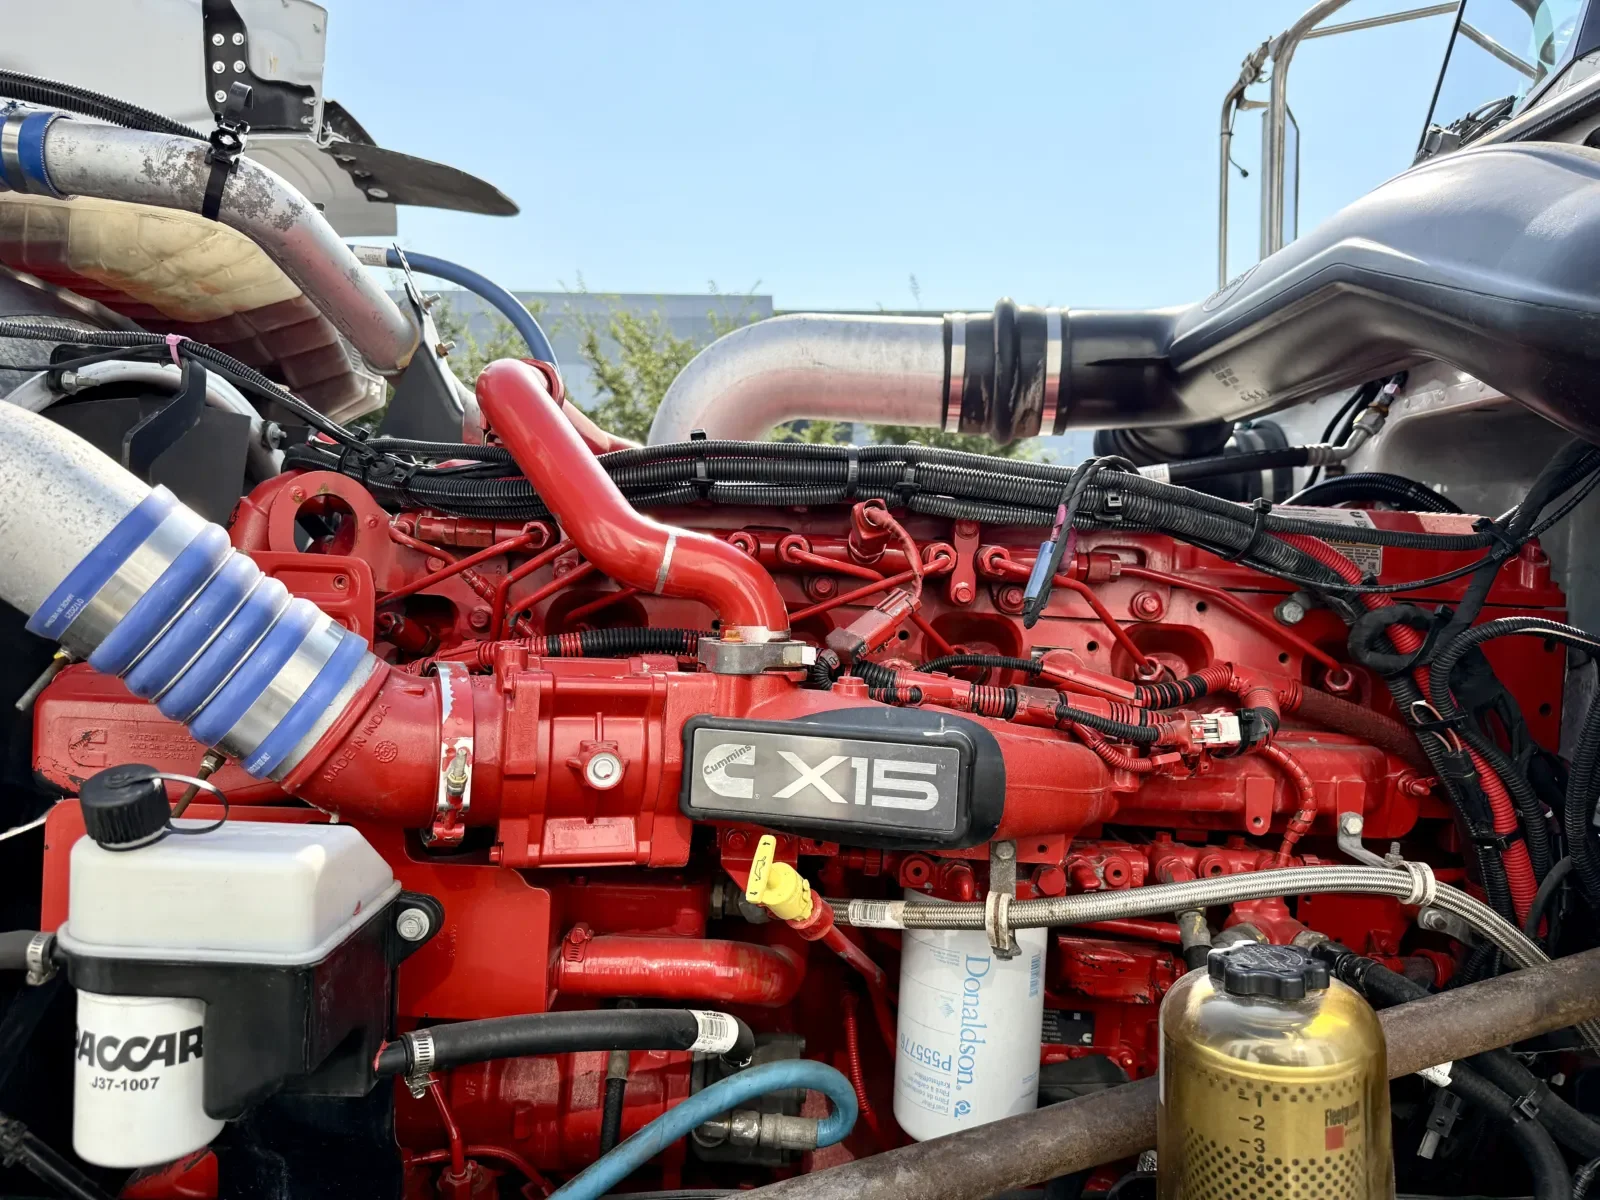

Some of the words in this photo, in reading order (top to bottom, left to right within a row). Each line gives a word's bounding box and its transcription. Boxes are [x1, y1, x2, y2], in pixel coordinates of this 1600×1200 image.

[323, 748, 356, 783] MADE
[351, 734, 368, 751] IN
[362, 704, 392, 736] INDIA
[703, 744, 752, 776] Cummins
[772, 751, 940, 811] X15
[957, 954, 991, 1086] Donaldson
[900, 1032, 952, 1072] P555776
[90, 1076, 161, 1092] J37-1007
[1252, 1114, 1265, 1131] 2
[1253, 1137, 1266, 1154] 3
